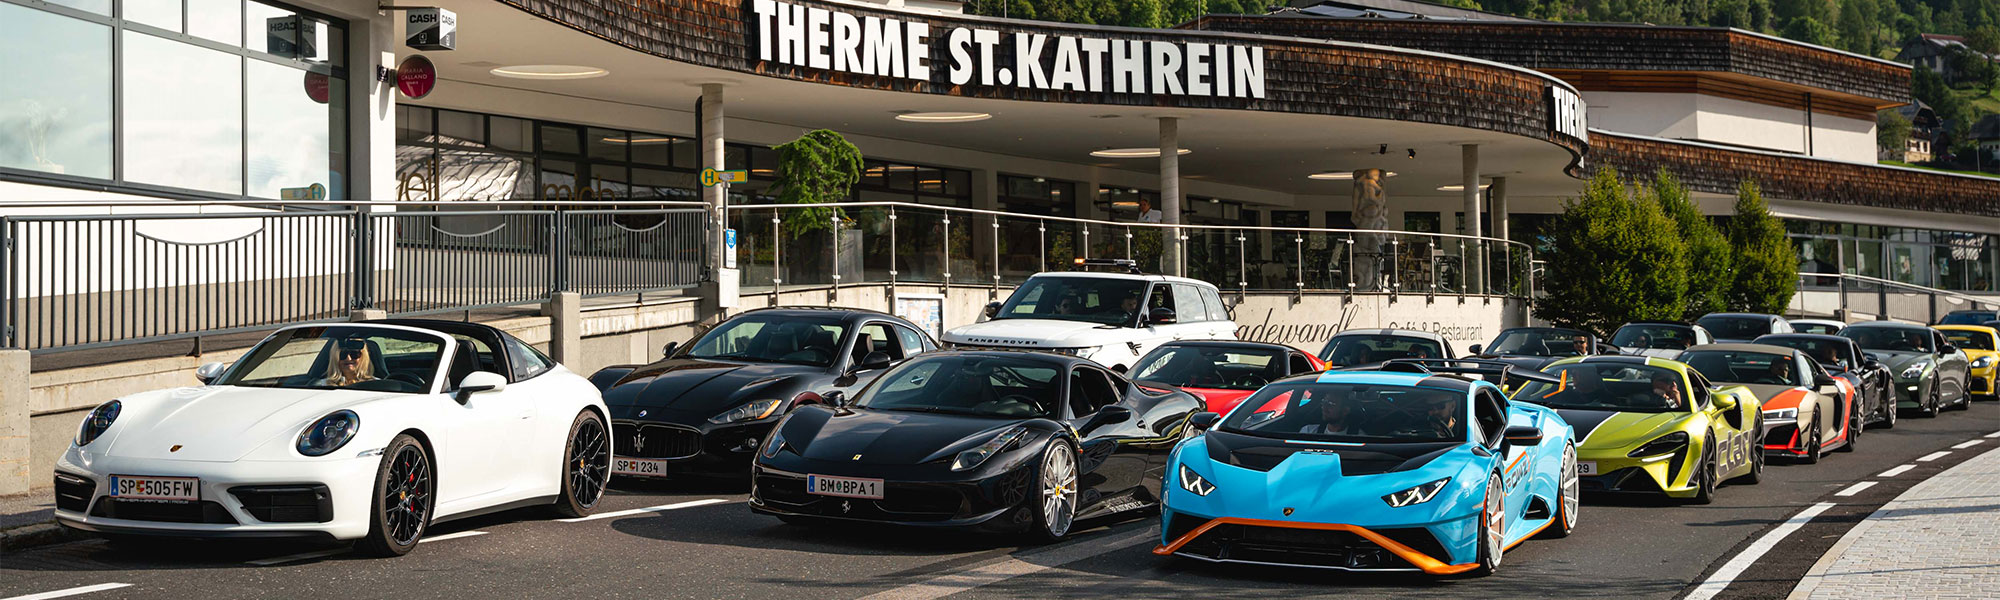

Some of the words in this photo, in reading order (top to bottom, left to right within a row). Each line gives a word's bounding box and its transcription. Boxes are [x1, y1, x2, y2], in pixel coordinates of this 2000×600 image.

[409, 14, 437, 23] CASH
[754, 0, 930, 81] THERME
[949, 27, 1265, 99] ST.KATHREIN
[705, 171, 713, 183] H
[1225, 304, 1359, 343] adewandl
[1433, 321, 1483, 341] Restaurant
[617, 460, 629, 471] SP
[641, 462, 659, 473] 234
[120, 479, 135, 494] SP
[146, 481, 171, 495] 505
[174, 482, 193, 496] FW
[821, 479, 834, 492] BM
[843, 481, 866, 495] BPA
